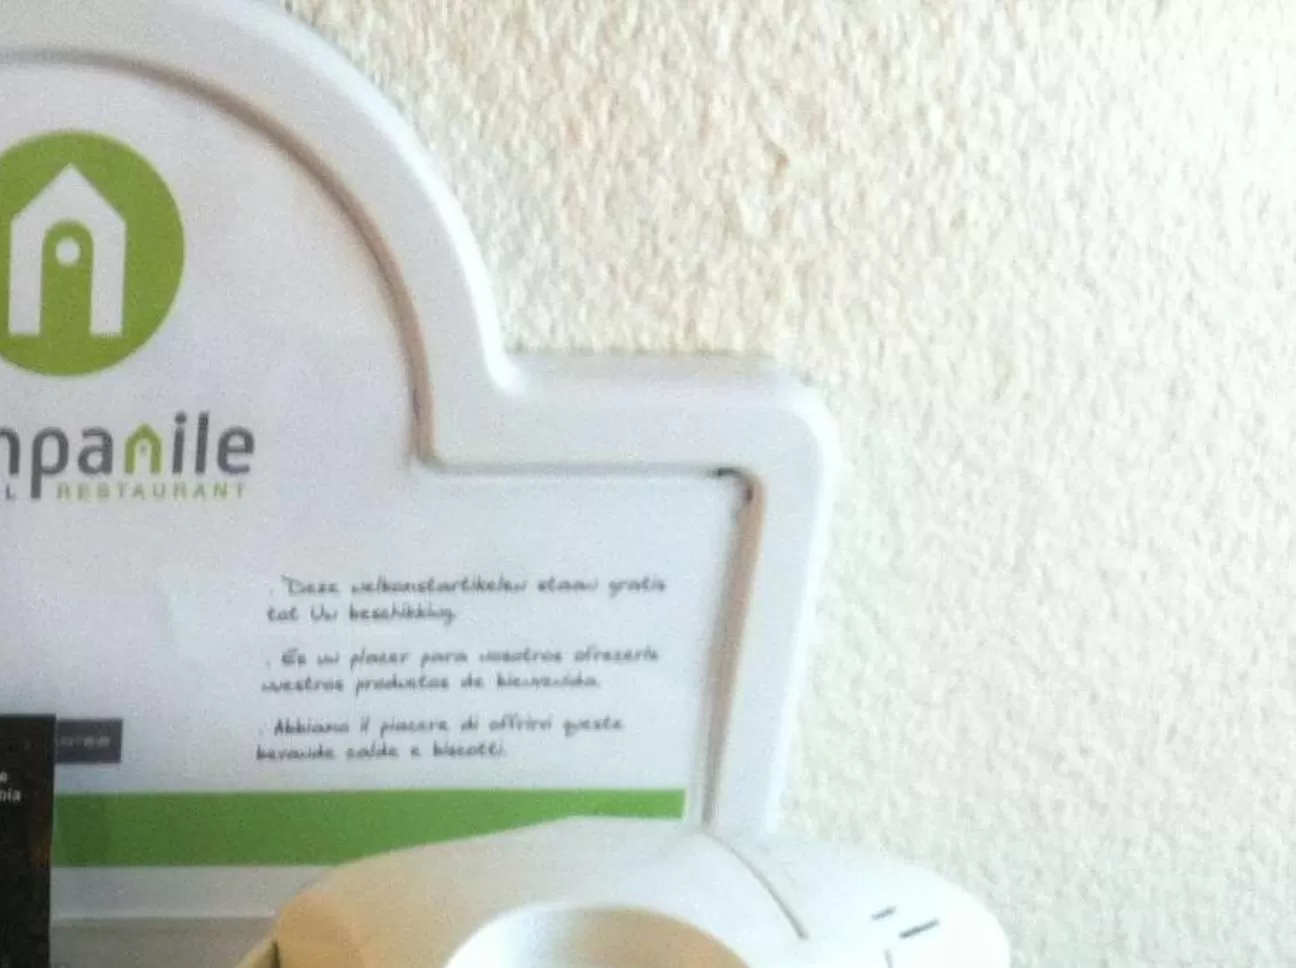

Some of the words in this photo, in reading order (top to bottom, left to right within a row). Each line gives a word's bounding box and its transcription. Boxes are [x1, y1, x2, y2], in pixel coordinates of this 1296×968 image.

[57, 481, 246, 500] RESTAURANT
[281, 574, 339, 595] Deze
[352, 574, 528, 593] welkomstartikelen
[537, 576, 599, 592] staan
[607, 574, 668, 599] gratis
[267, 606, 299, 622] tot
[310, 604, 338, 621] Uw
[281, 647, 307, 664] Es
[316, 652, 340, 664] un
[350, 647, 407, 672] placer
[420, 652, 469, 669] para
[261, 676, 345, 692] nuestros
[355, 673, 450, 698] productos
[461, 672, 484, 689] de
[274, 716, 349, 736] Abbiamo
[380, 718, 449, 739] piacere
[461, 714, 479, 732] di
[488, 713, 553, 732] offrirvi
[562, 715, 623, 738] queste
[256, 744, 335, 761] bevande
[345, 740, 400, 759] calde
[410, 746, 422, 758] e
